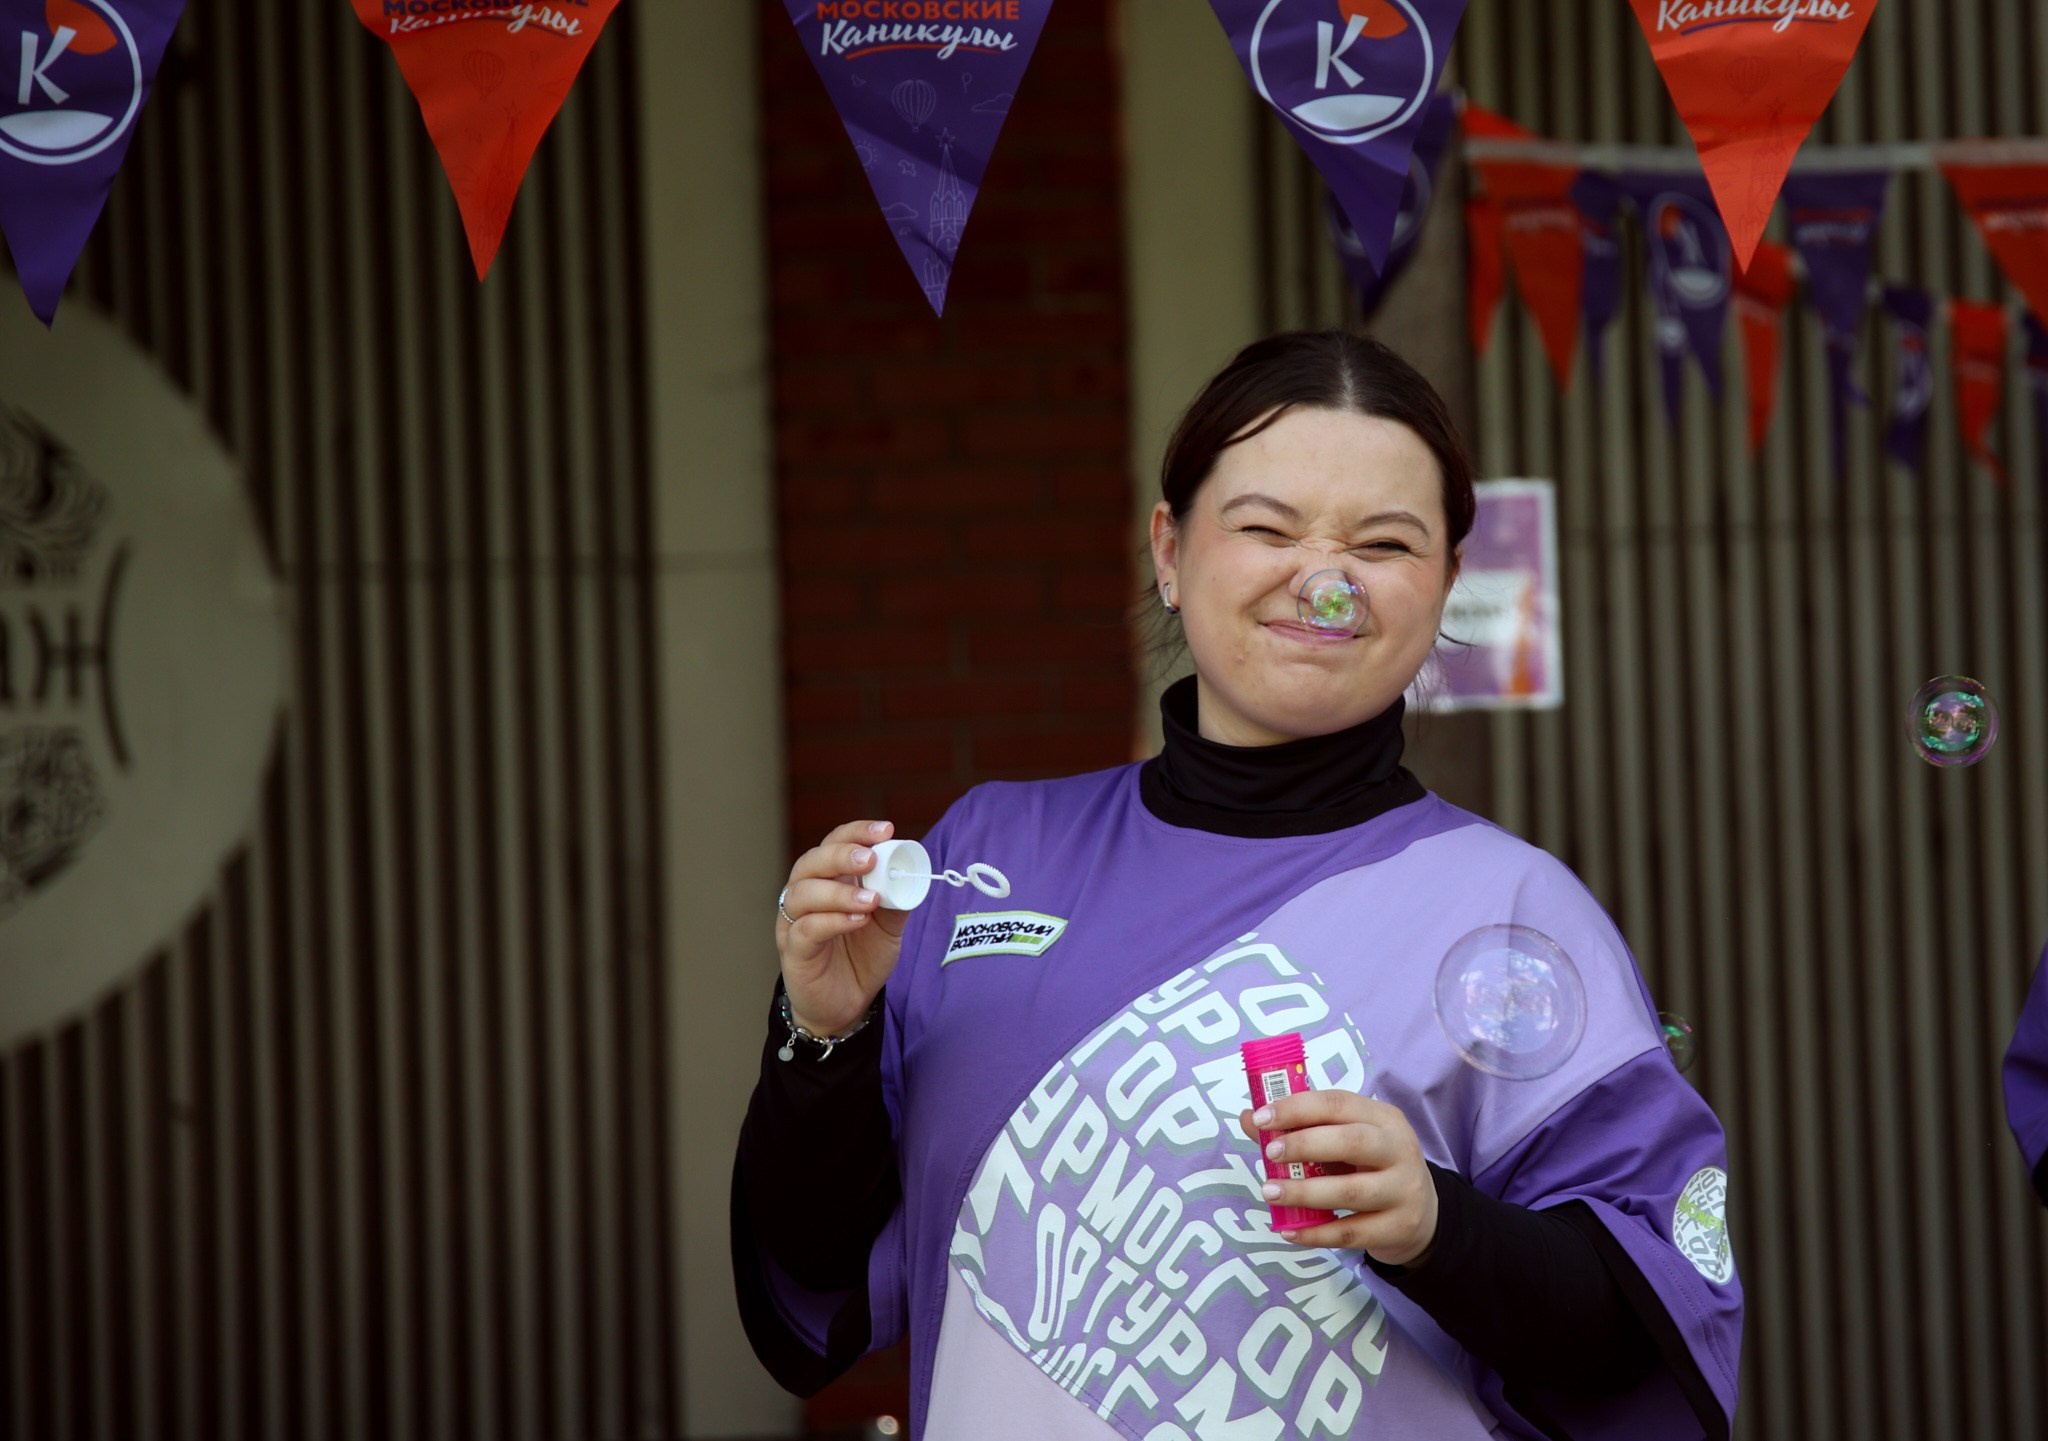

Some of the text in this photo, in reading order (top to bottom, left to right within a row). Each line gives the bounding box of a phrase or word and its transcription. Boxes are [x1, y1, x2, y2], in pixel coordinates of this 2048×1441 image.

[816, 0, 1020, 20] МОСКОВСКИЕ
[1657, 0, 1854, 33] Каникулы
[820, 19, 1018, 60] Каникулы
[956, 921, 1055, 939] МОСКОВСКИЙ
